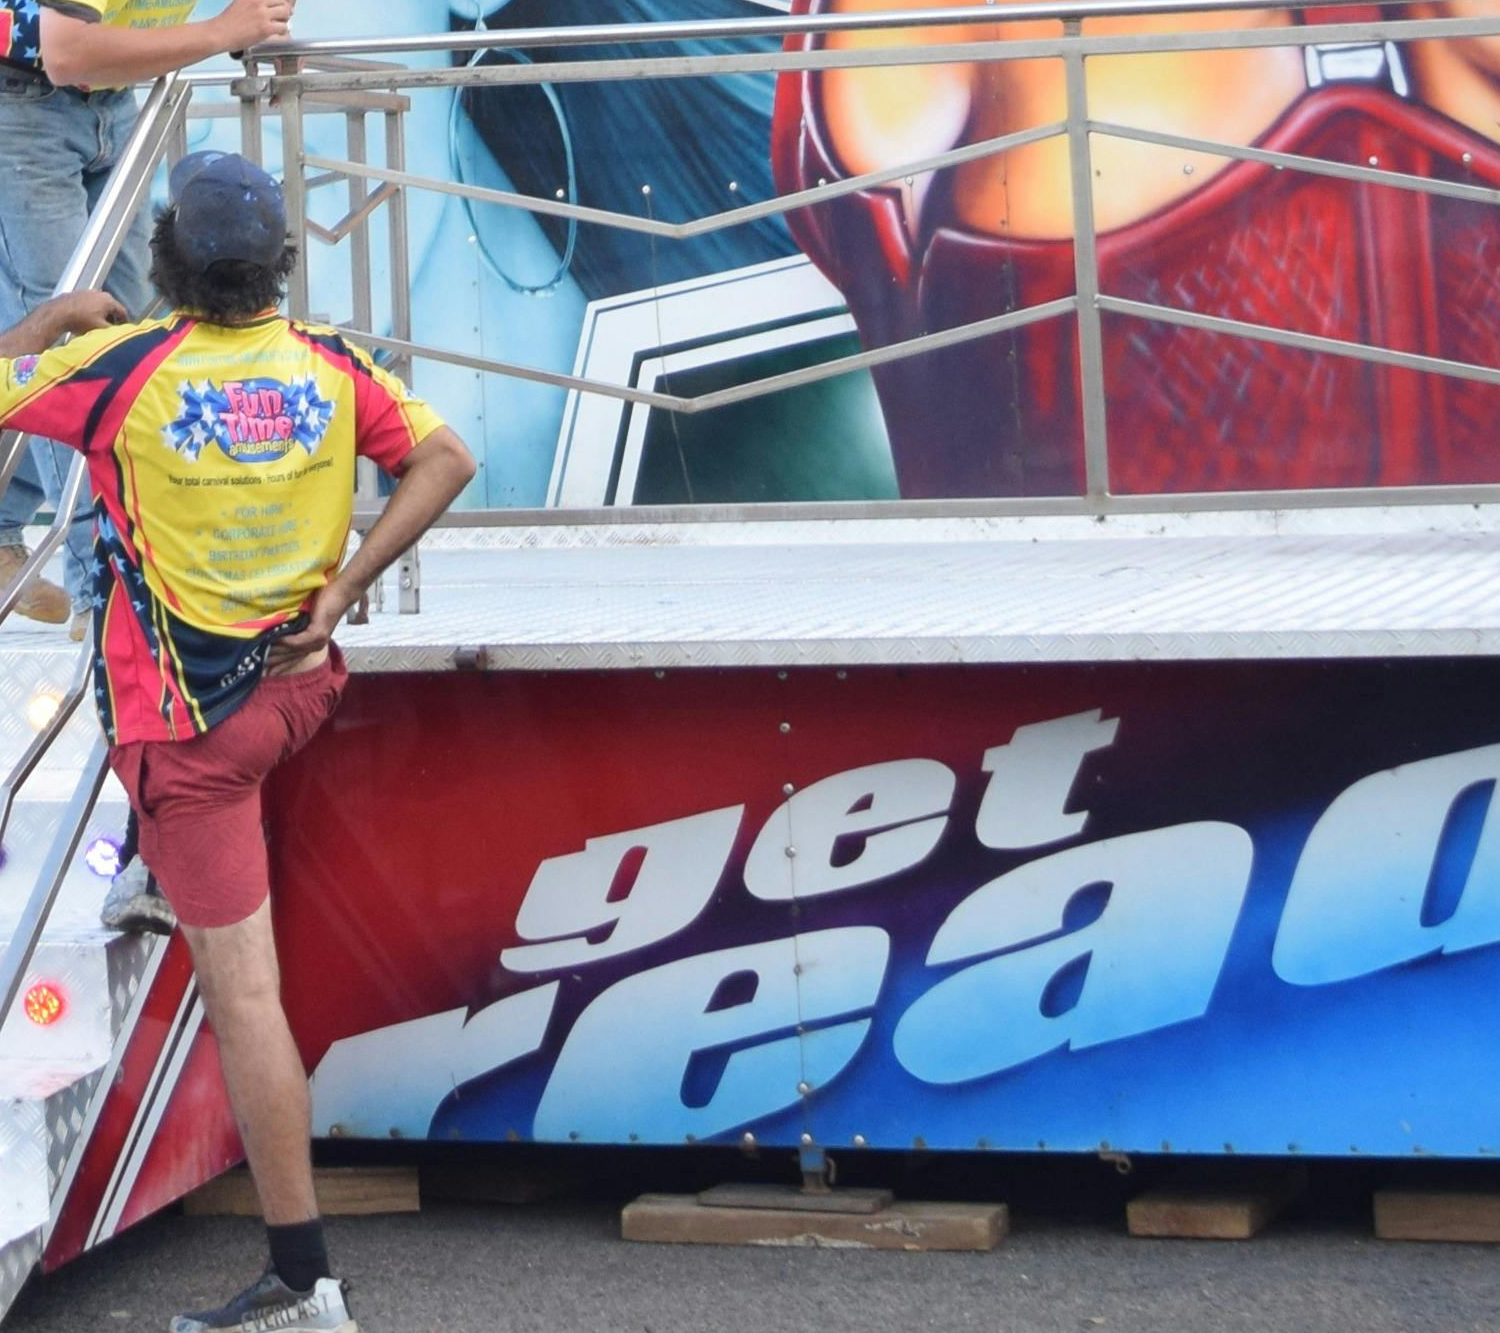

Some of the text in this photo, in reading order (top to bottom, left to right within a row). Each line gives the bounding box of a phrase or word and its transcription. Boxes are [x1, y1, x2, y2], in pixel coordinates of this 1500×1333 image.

[222, 381, 283, 416] Fun
[219, 414, 294, 442] Time
[229, 440, 295, 456] amusements
[185, 476, 200, 486] total
[201, 475, 230, 486] carnival
[230, 475, 262, 486] solutions
[266, 472, 286, 483] hours
[500, 707, 1120, 974] get
[240, 1293, 331, 1333] EVERLAST
